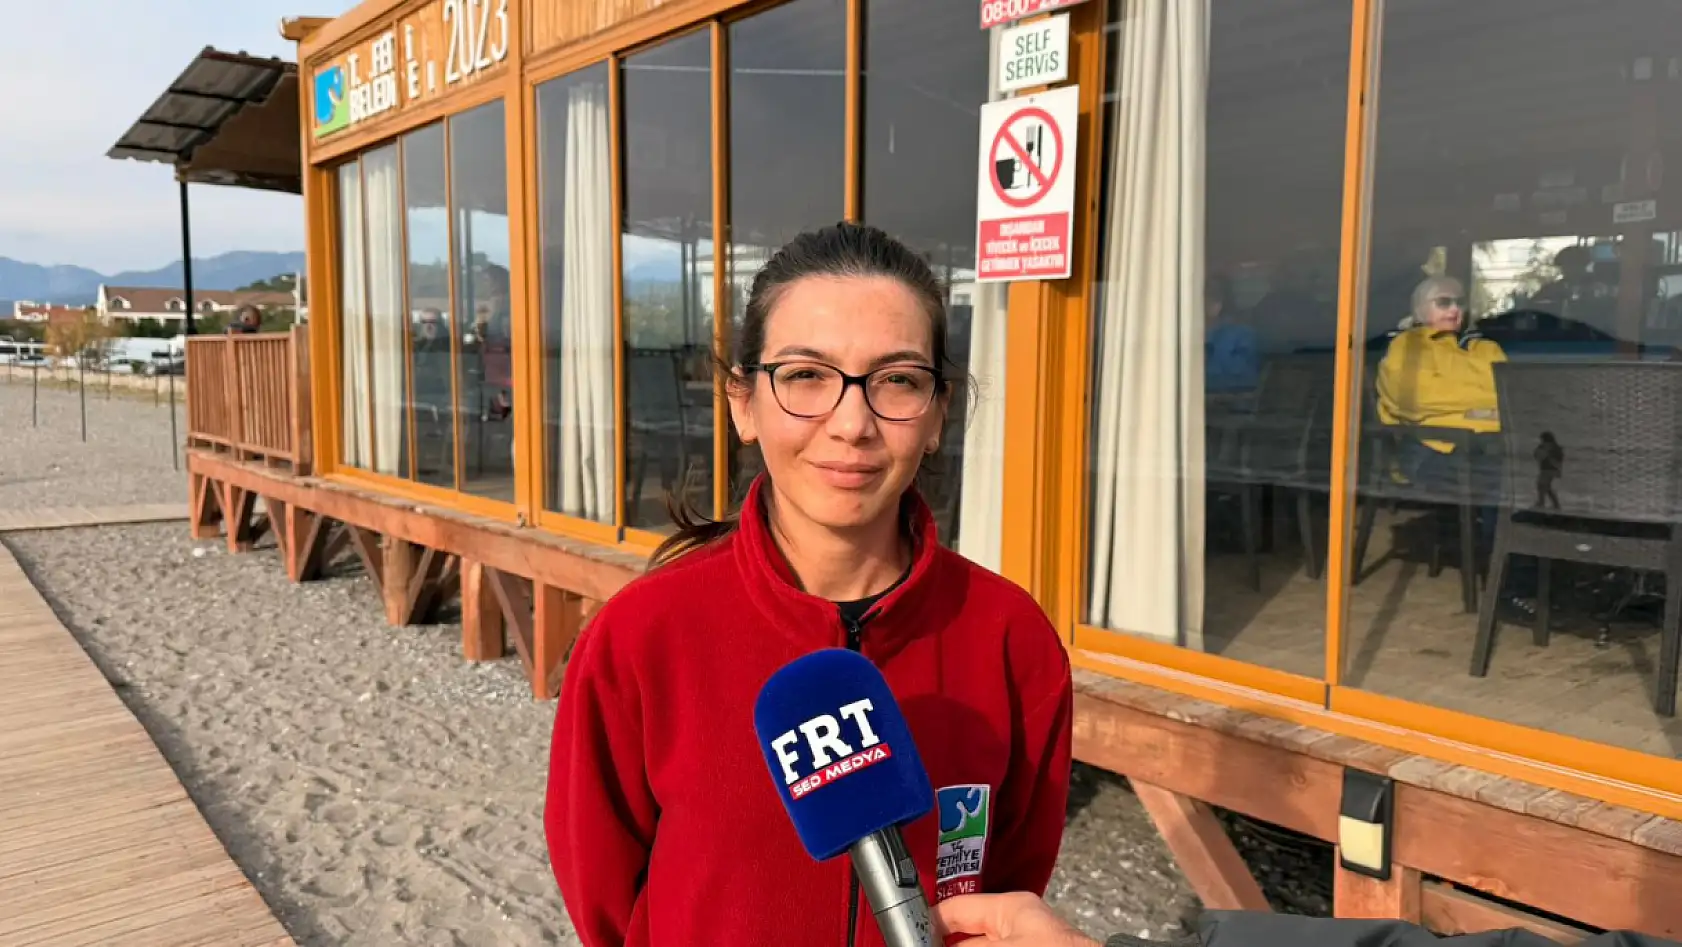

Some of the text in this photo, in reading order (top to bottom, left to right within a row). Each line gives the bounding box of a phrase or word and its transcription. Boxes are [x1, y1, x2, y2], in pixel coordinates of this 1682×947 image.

[444, 0, 508, 84] 2023
[1015, 28, 1051, 56] SELF
[771, 698, 880, 785] FRT
[793, 747, 887, 796] SED MEDYA
